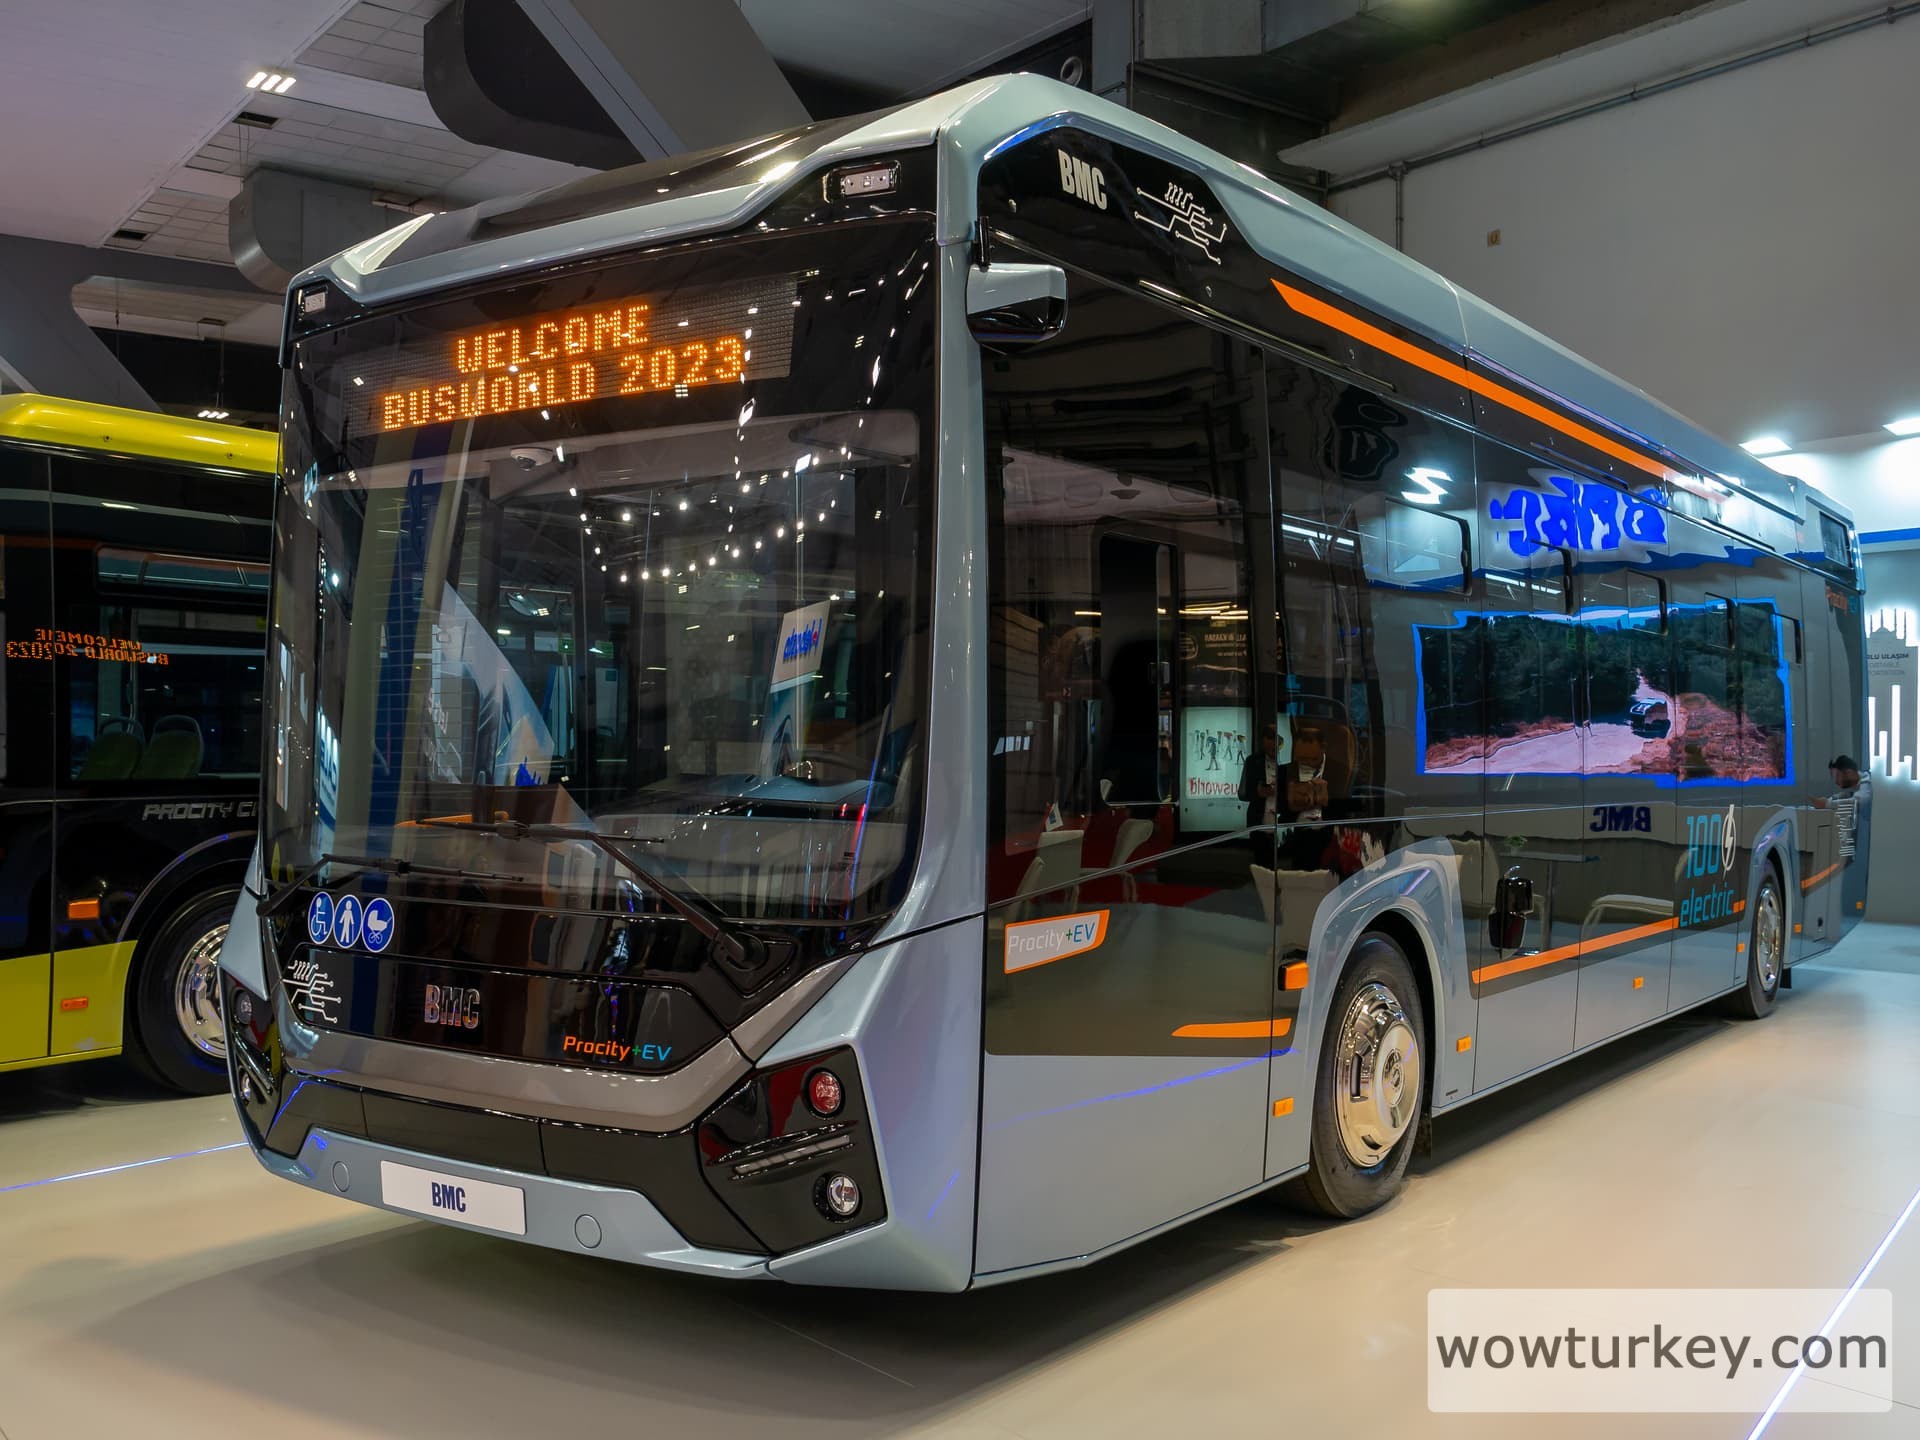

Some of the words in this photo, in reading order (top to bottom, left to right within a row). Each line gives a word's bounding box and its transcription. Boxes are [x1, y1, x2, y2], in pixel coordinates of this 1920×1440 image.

[1058, 149, 1107, 210] BMC
[457, 304, 650, 374] WELCOME
[384, 361, 596, 430] BUSWORLD
[620, 337, 742, 393] 2023
[142, 802, 233, 821] PROCITY
[1680, 883, 1735, 927] electric
[424, 984, 480, 1030] BMC
[431, 1181, 467, 1213] BMC
